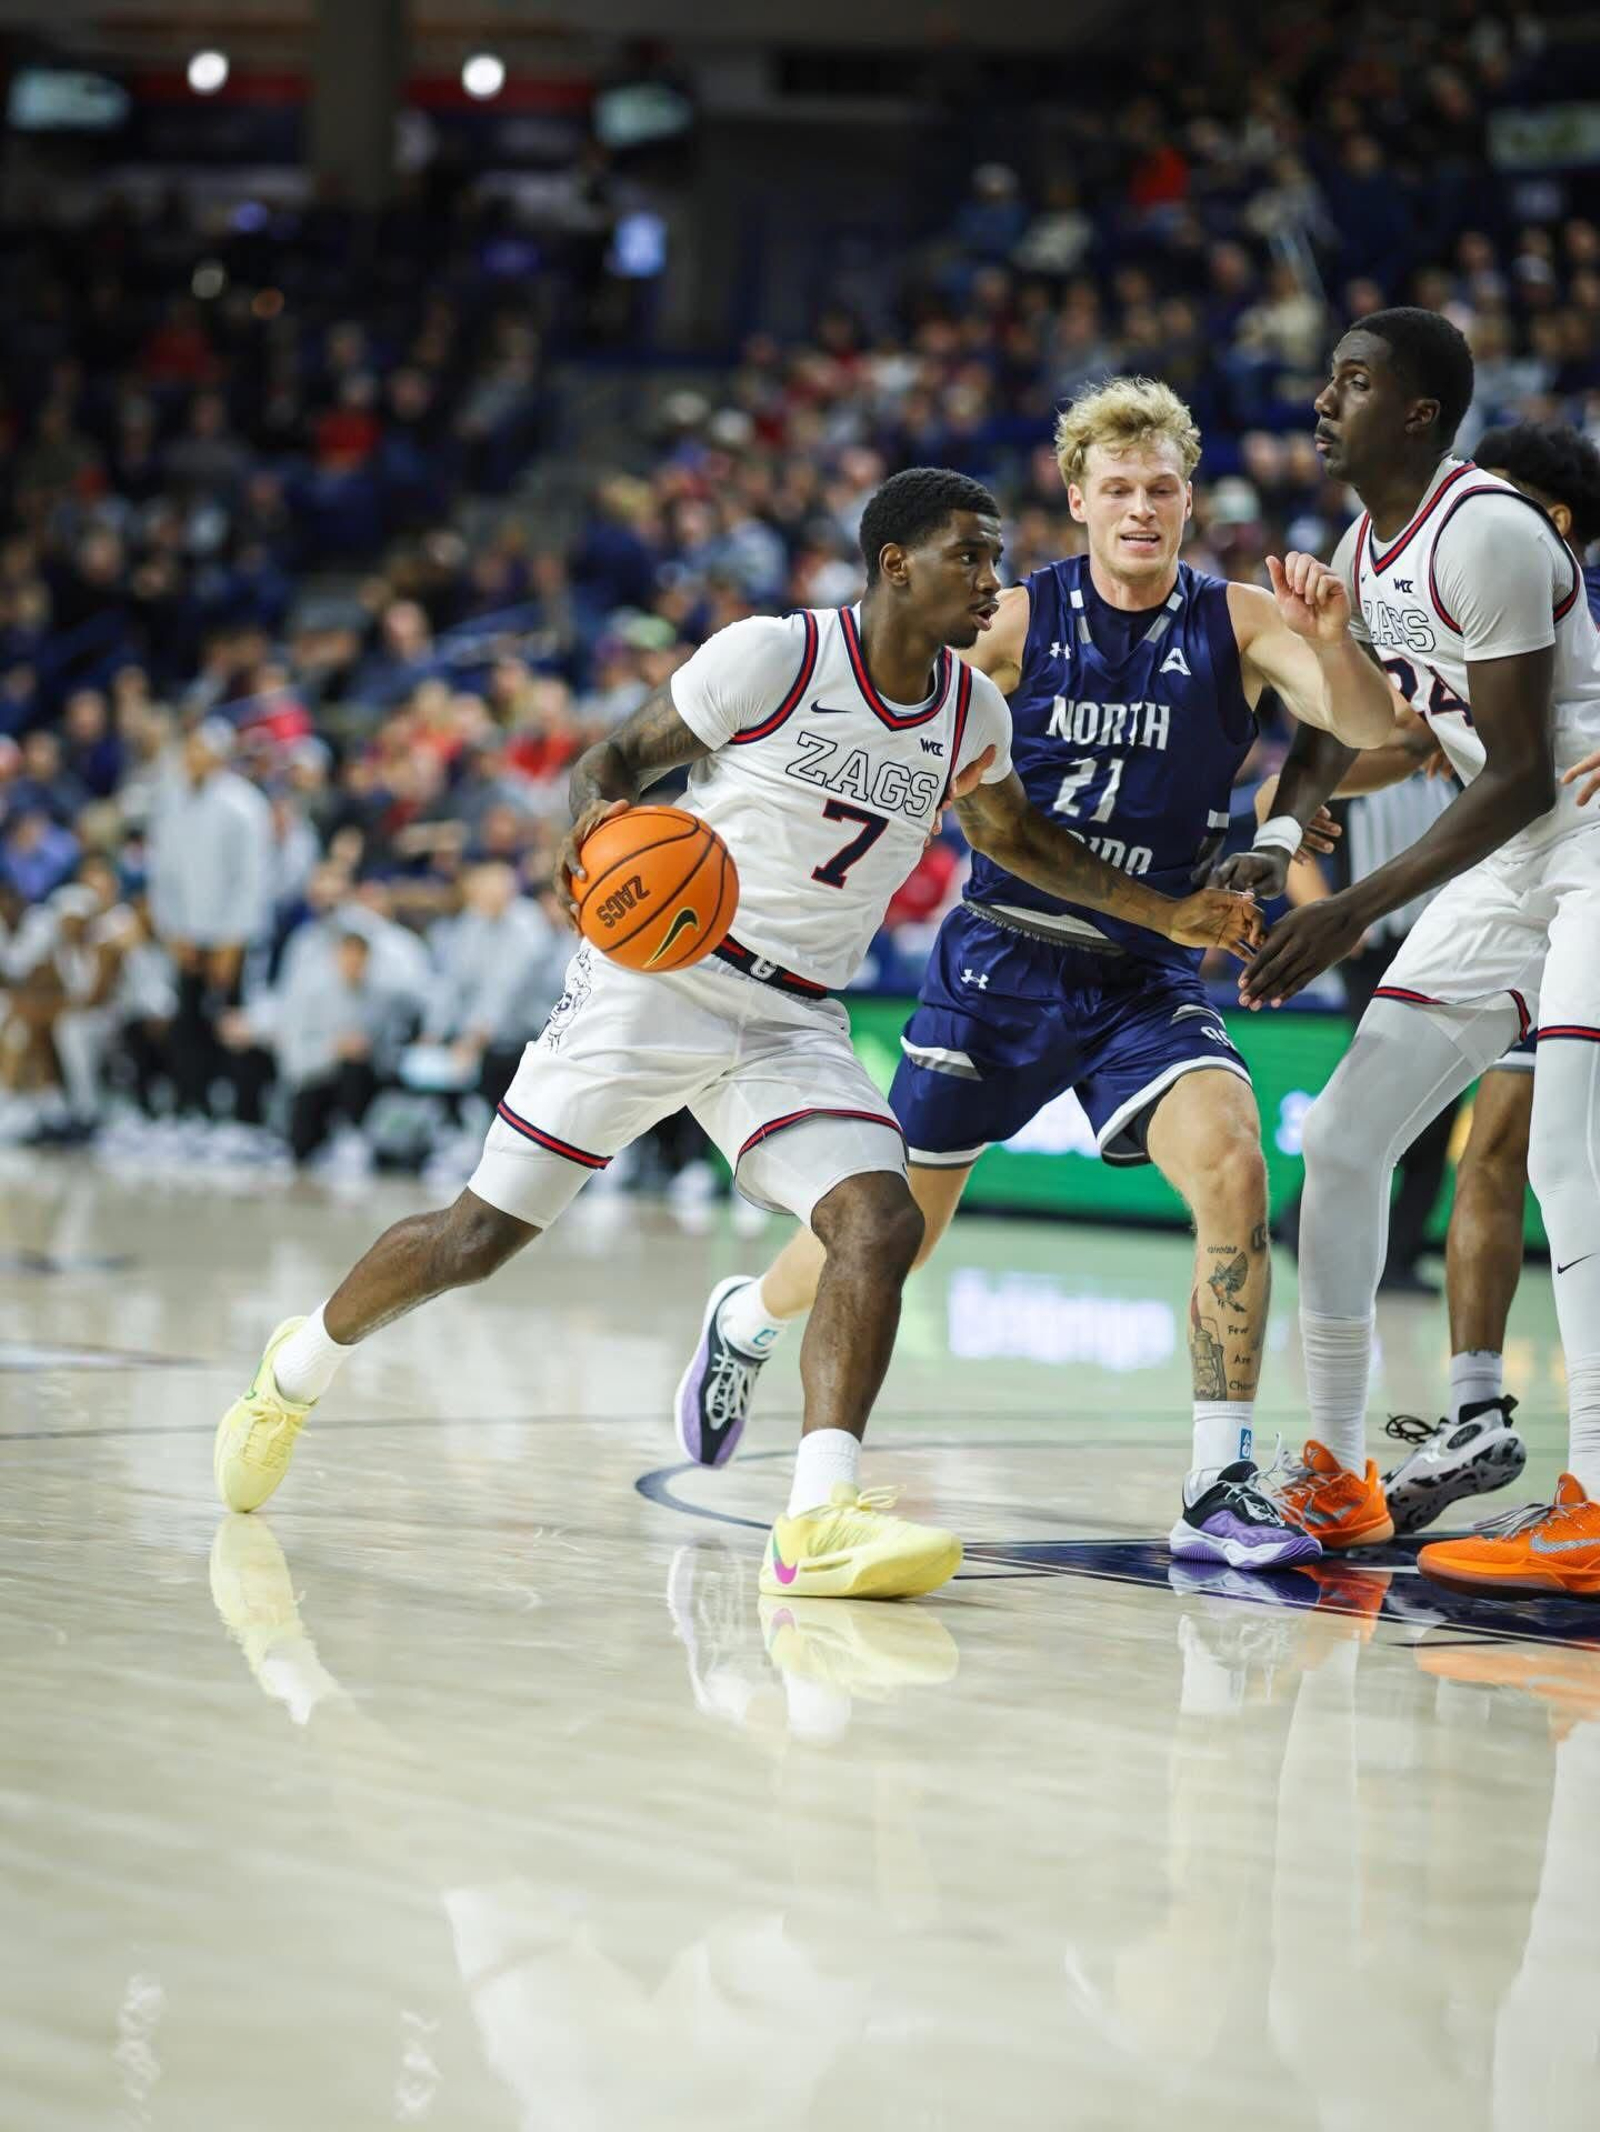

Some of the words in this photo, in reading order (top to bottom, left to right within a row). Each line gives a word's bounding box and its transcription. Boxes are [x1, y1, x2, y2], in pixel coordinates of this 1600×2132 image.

[1045, 694, 1171, 751] NORTH
[785, 731, 940, 819] ZAGS
[1052, 757, 1125, 824] 21
[810, 798, 890, 890] 7
[595, 874, 650, 929] ZAGS
